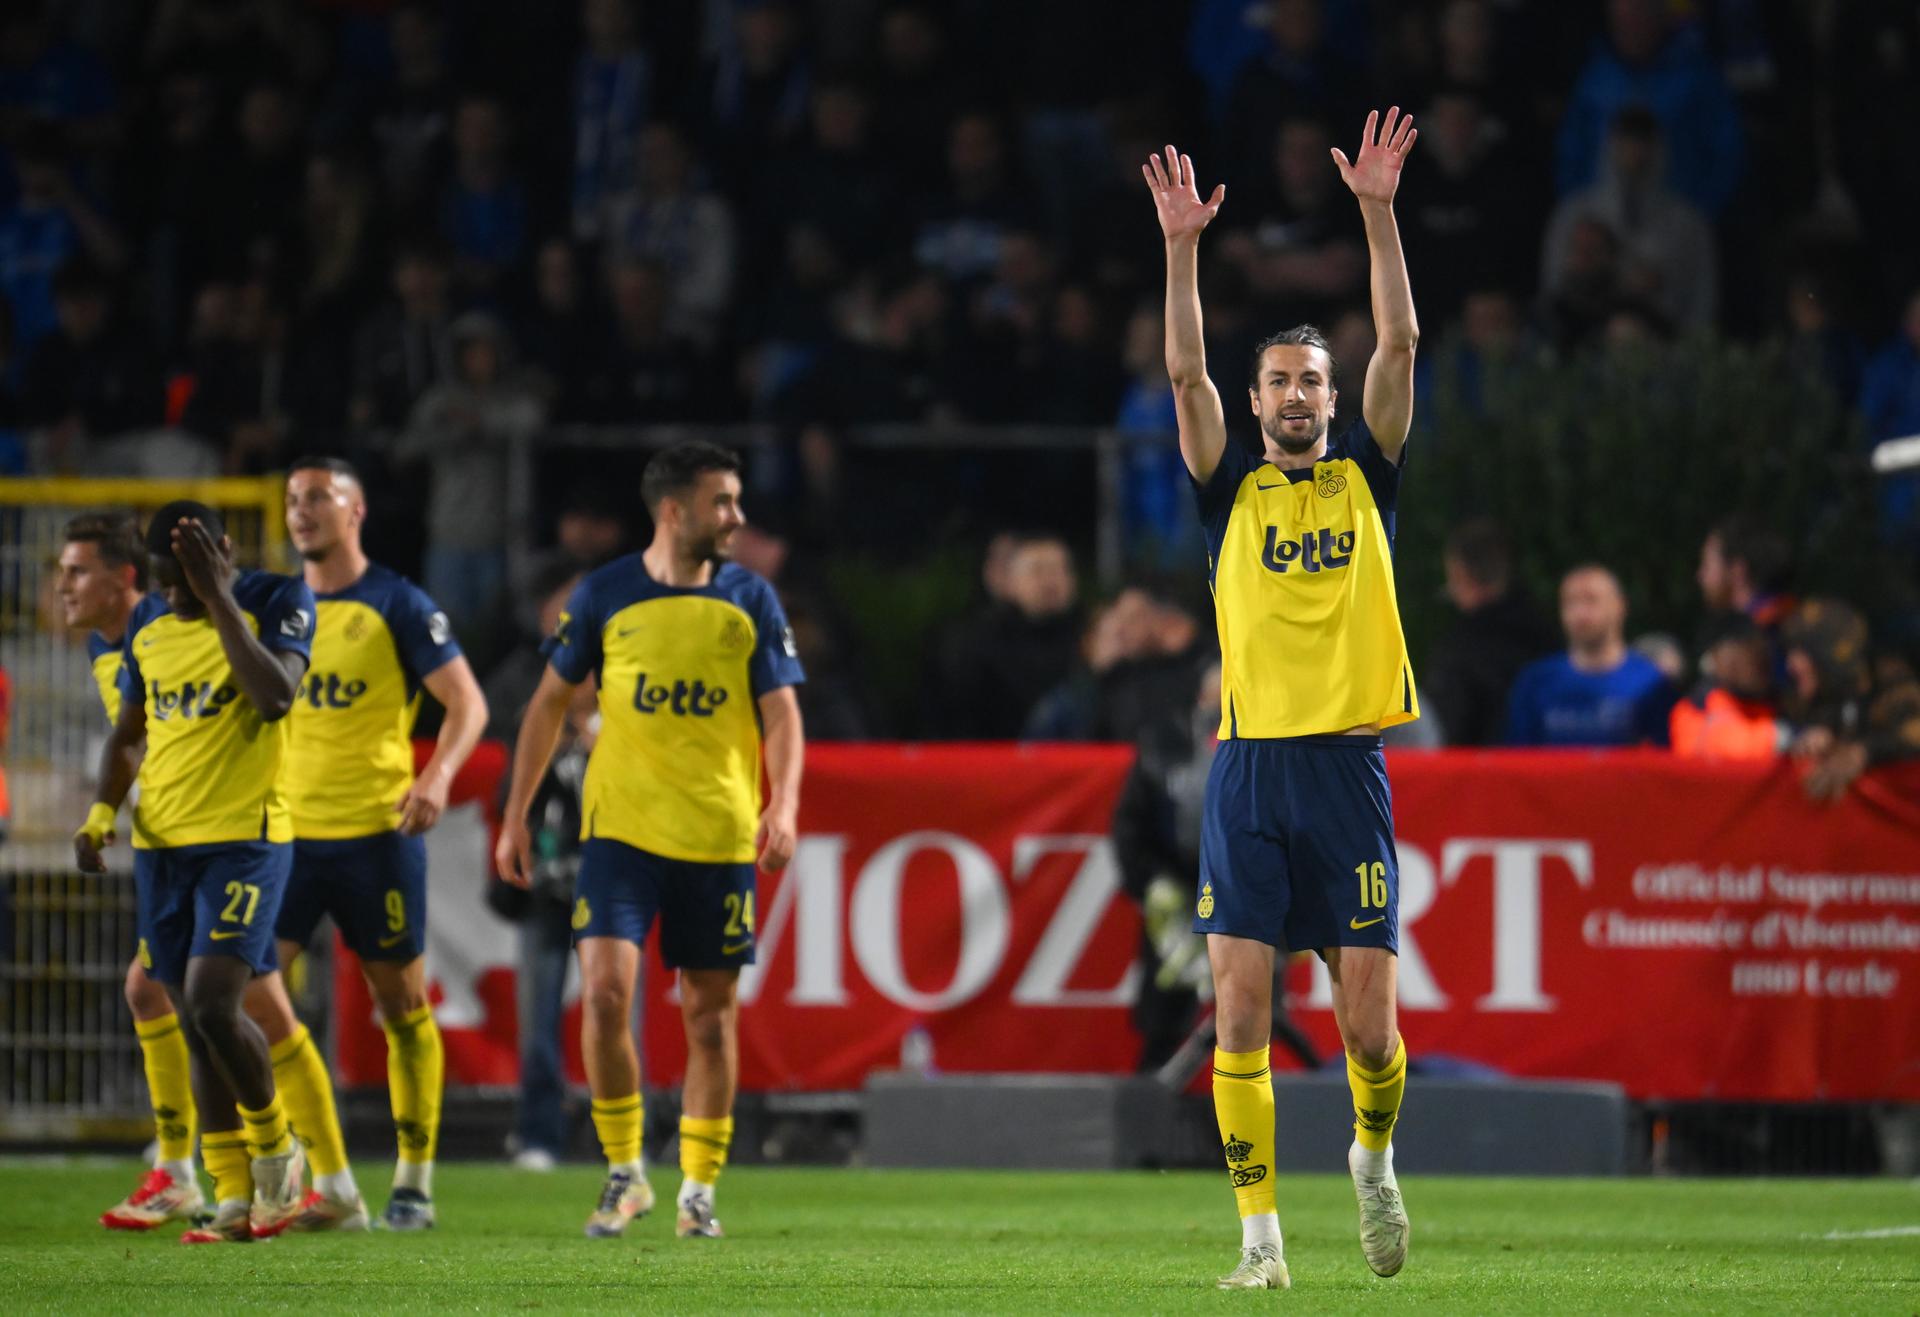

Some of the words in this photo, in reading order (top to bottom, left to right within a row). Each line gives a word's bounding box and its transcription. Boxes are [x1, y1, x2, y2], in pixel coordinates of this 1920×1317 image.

[298, 665, 367, 709] tto
[220, 881, 260, 926] 27
[1354, 861, 1388, 908] 16
[384, 889, 406, 932] 9
[723, 889, 756, 936] 24
